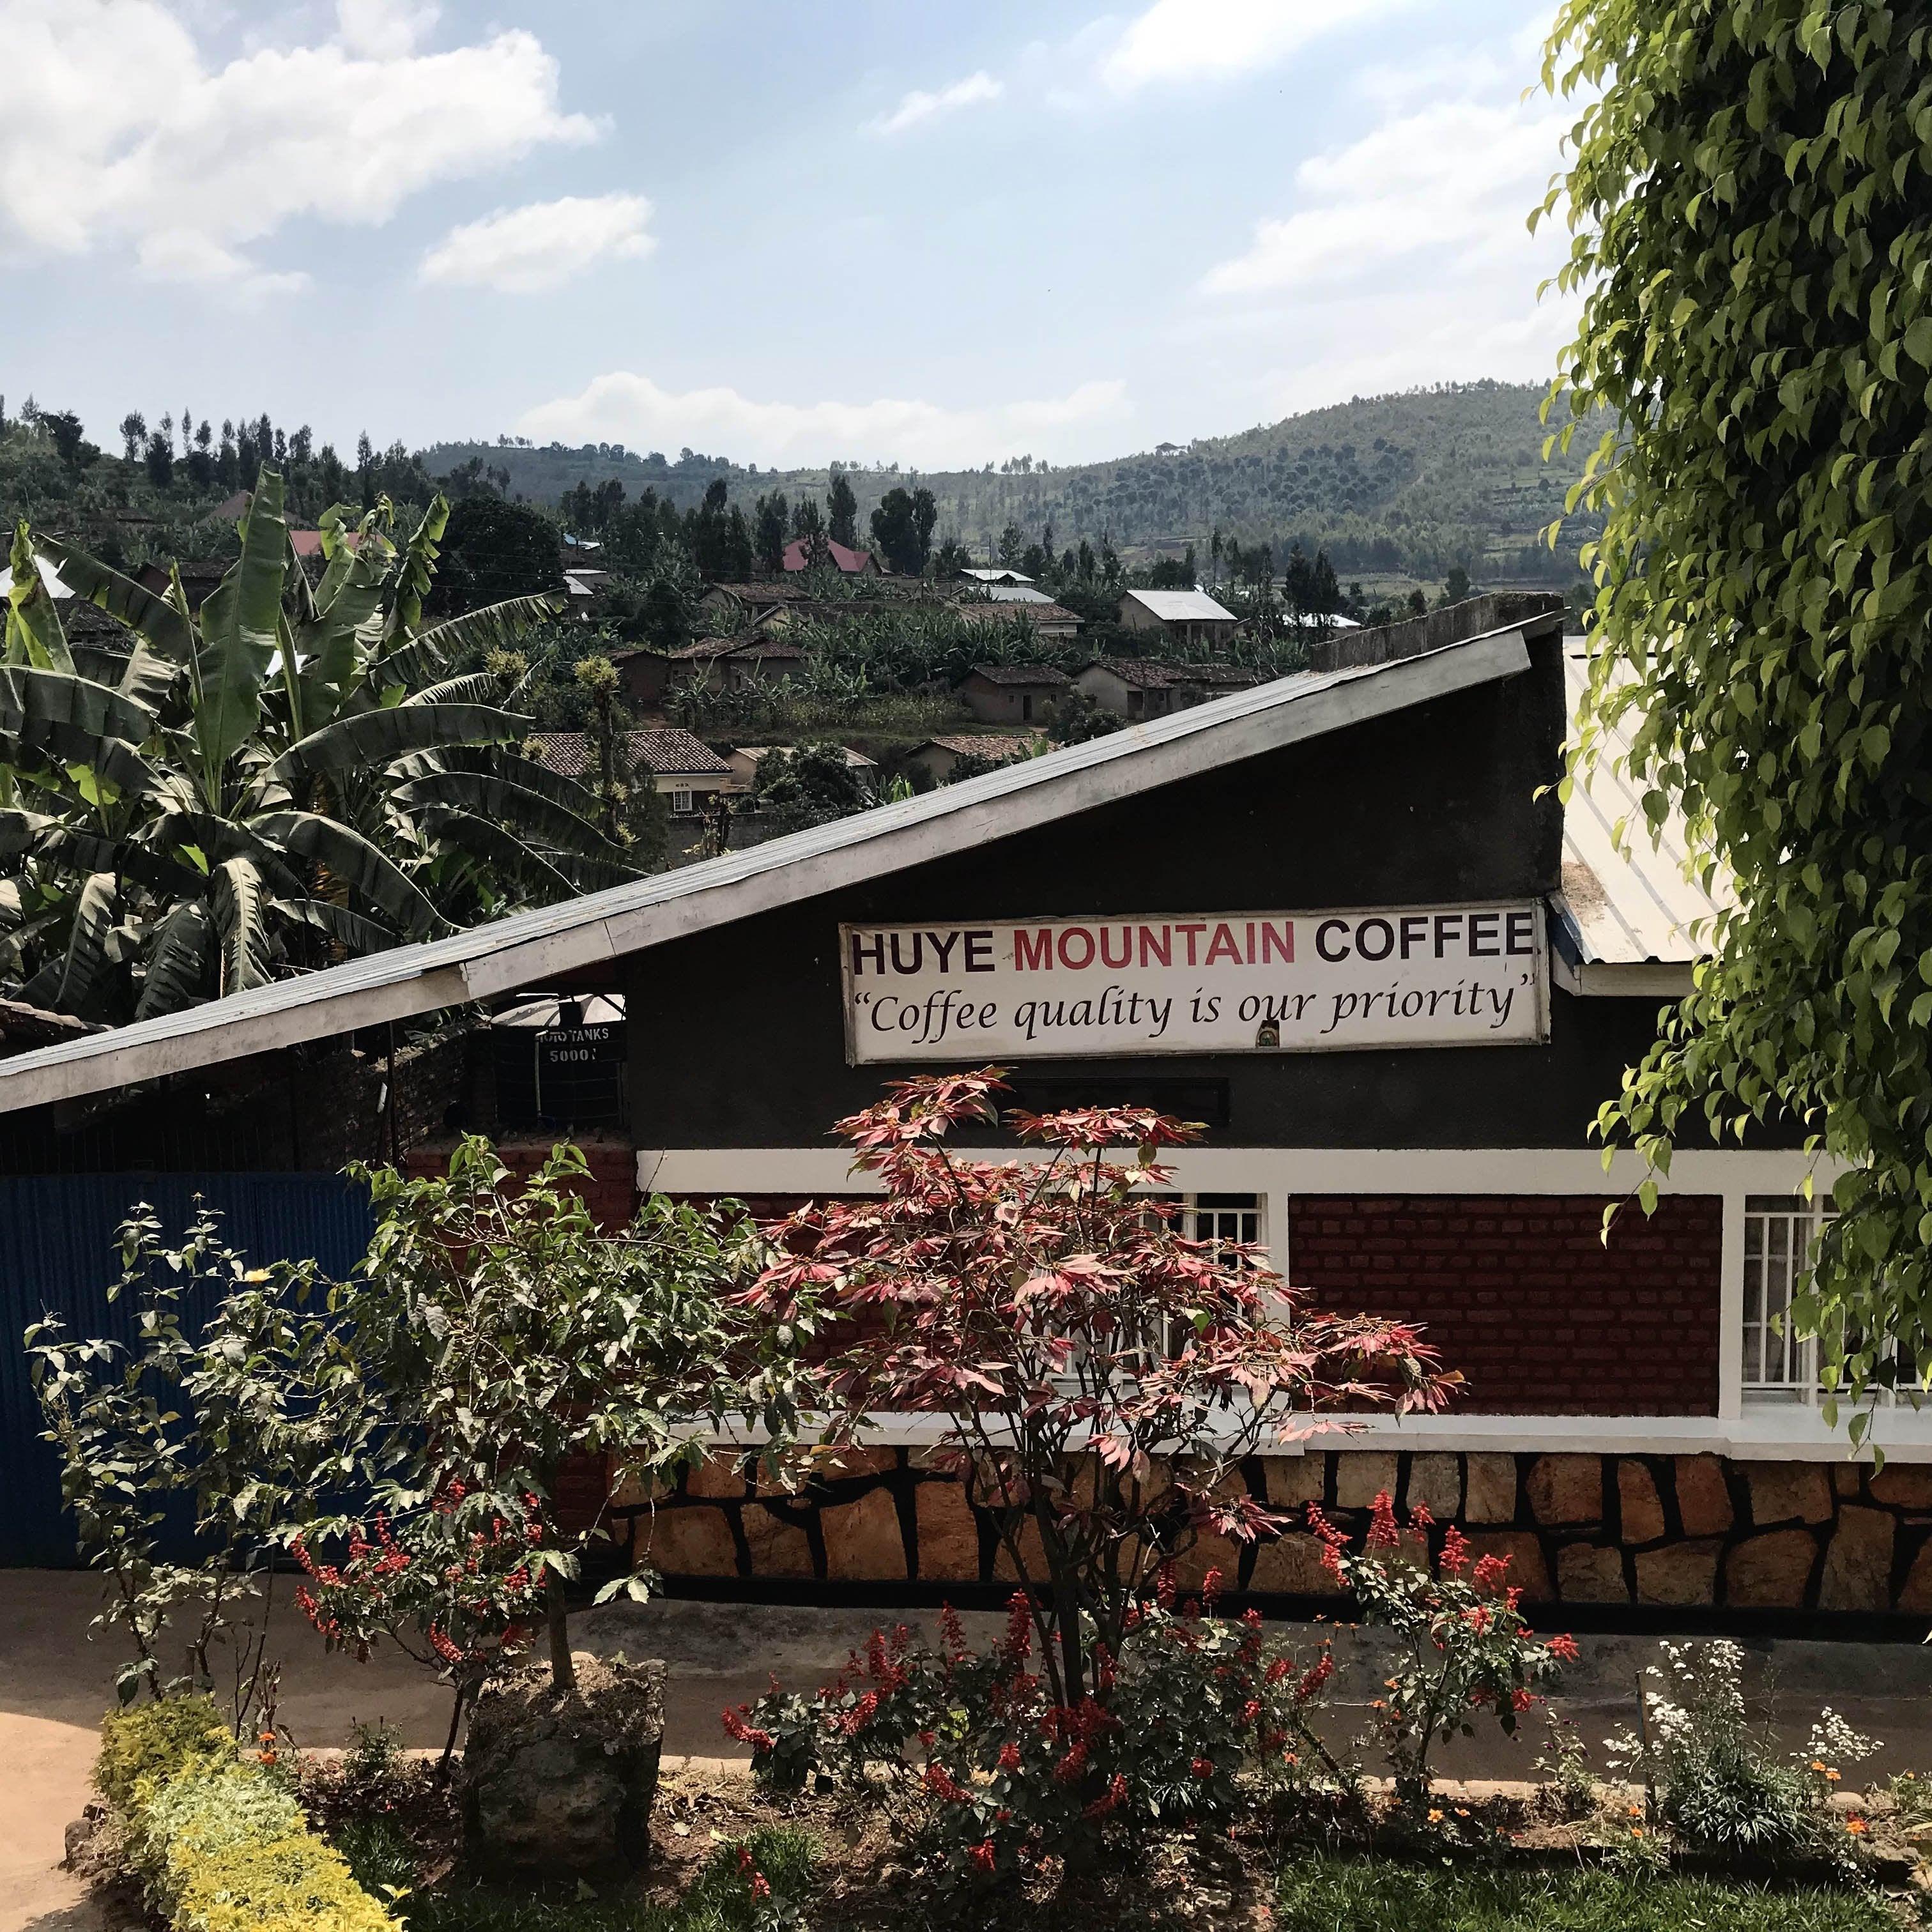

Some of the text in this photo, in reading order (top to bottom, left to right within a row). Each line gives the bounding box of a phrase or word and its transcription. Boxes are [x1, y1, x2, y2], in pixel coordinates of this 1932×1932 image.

[852, 912, 1533, 975] HUYE MOUNTAIN COFFEE
[568, 1027, 609, 1042] TANKS
[854, 988, 997, 1044] “Coffee
[1014, 985, 1172, 1041] quality
[1190, 986, 1222, 1023] is
[1238, 992, 1316, 1022] our
